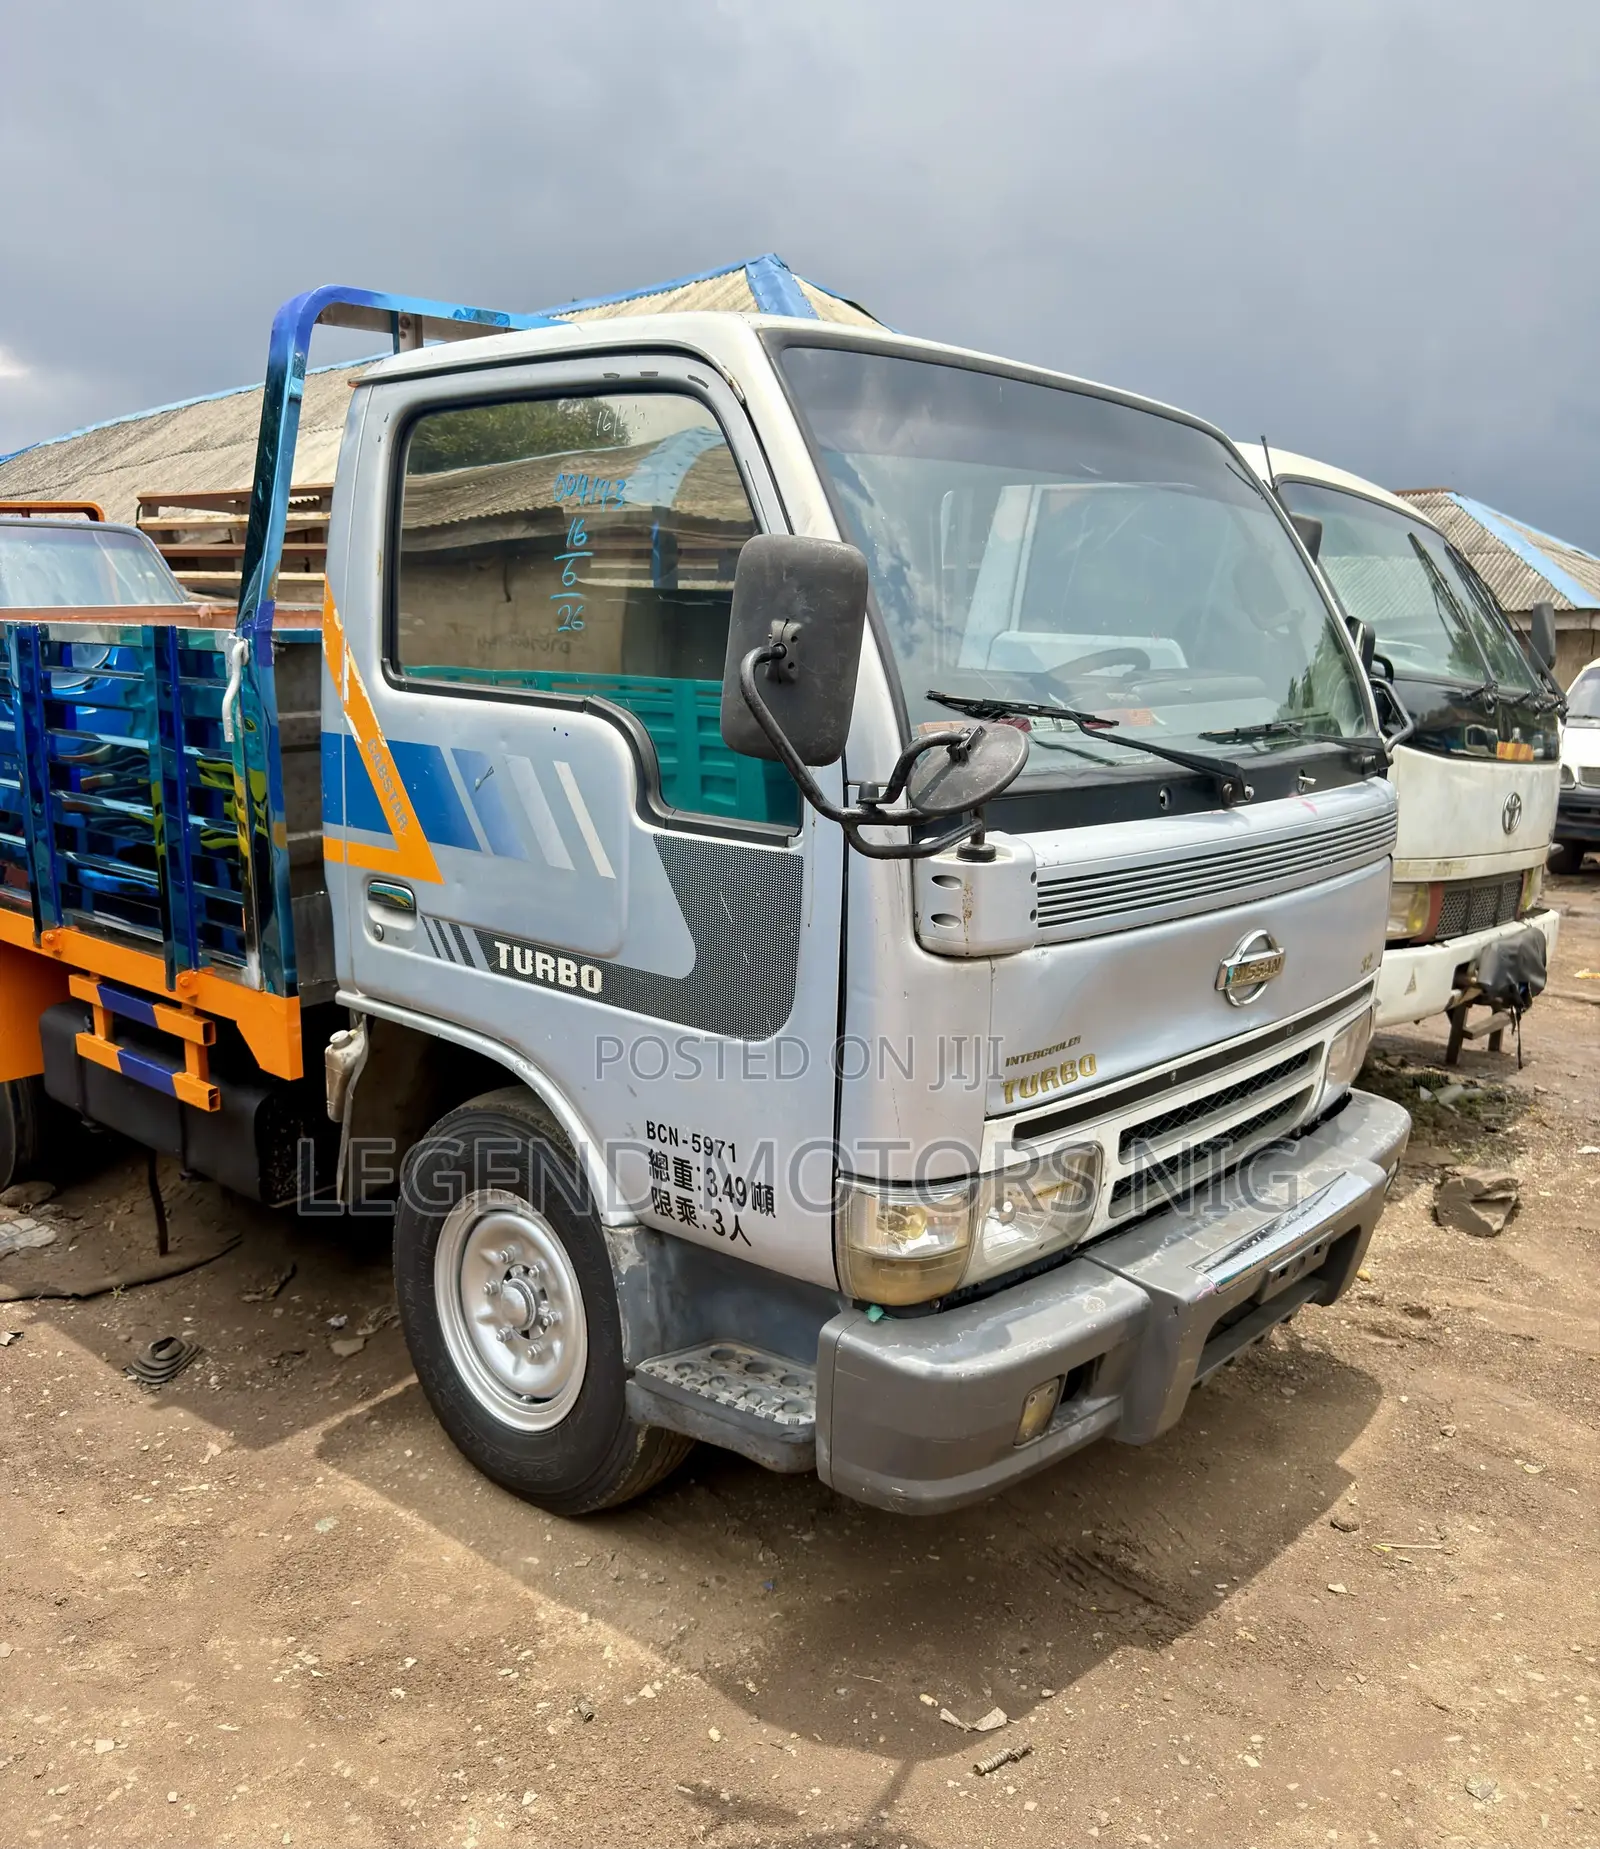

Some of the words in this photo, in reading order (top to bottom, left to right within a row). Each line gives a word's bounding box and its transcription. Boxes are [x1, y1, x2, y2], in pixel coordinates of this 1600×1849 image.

[565, 517, 588, 548] 16
[562, 559, 577, 587] 6
[557, 604, 585, 633] 26
[367, 738, 408, 833] CABSTAR
[494, 940, 602, 994] TURBO
[1233, 956, 1282, 983] NISSAN
[1005, 1035, 1082, 1067] INTERCOOLER
[1000, 1053, 1098, 1104] TURBO
[646, 1120, 736, 1163] BCN-5971
